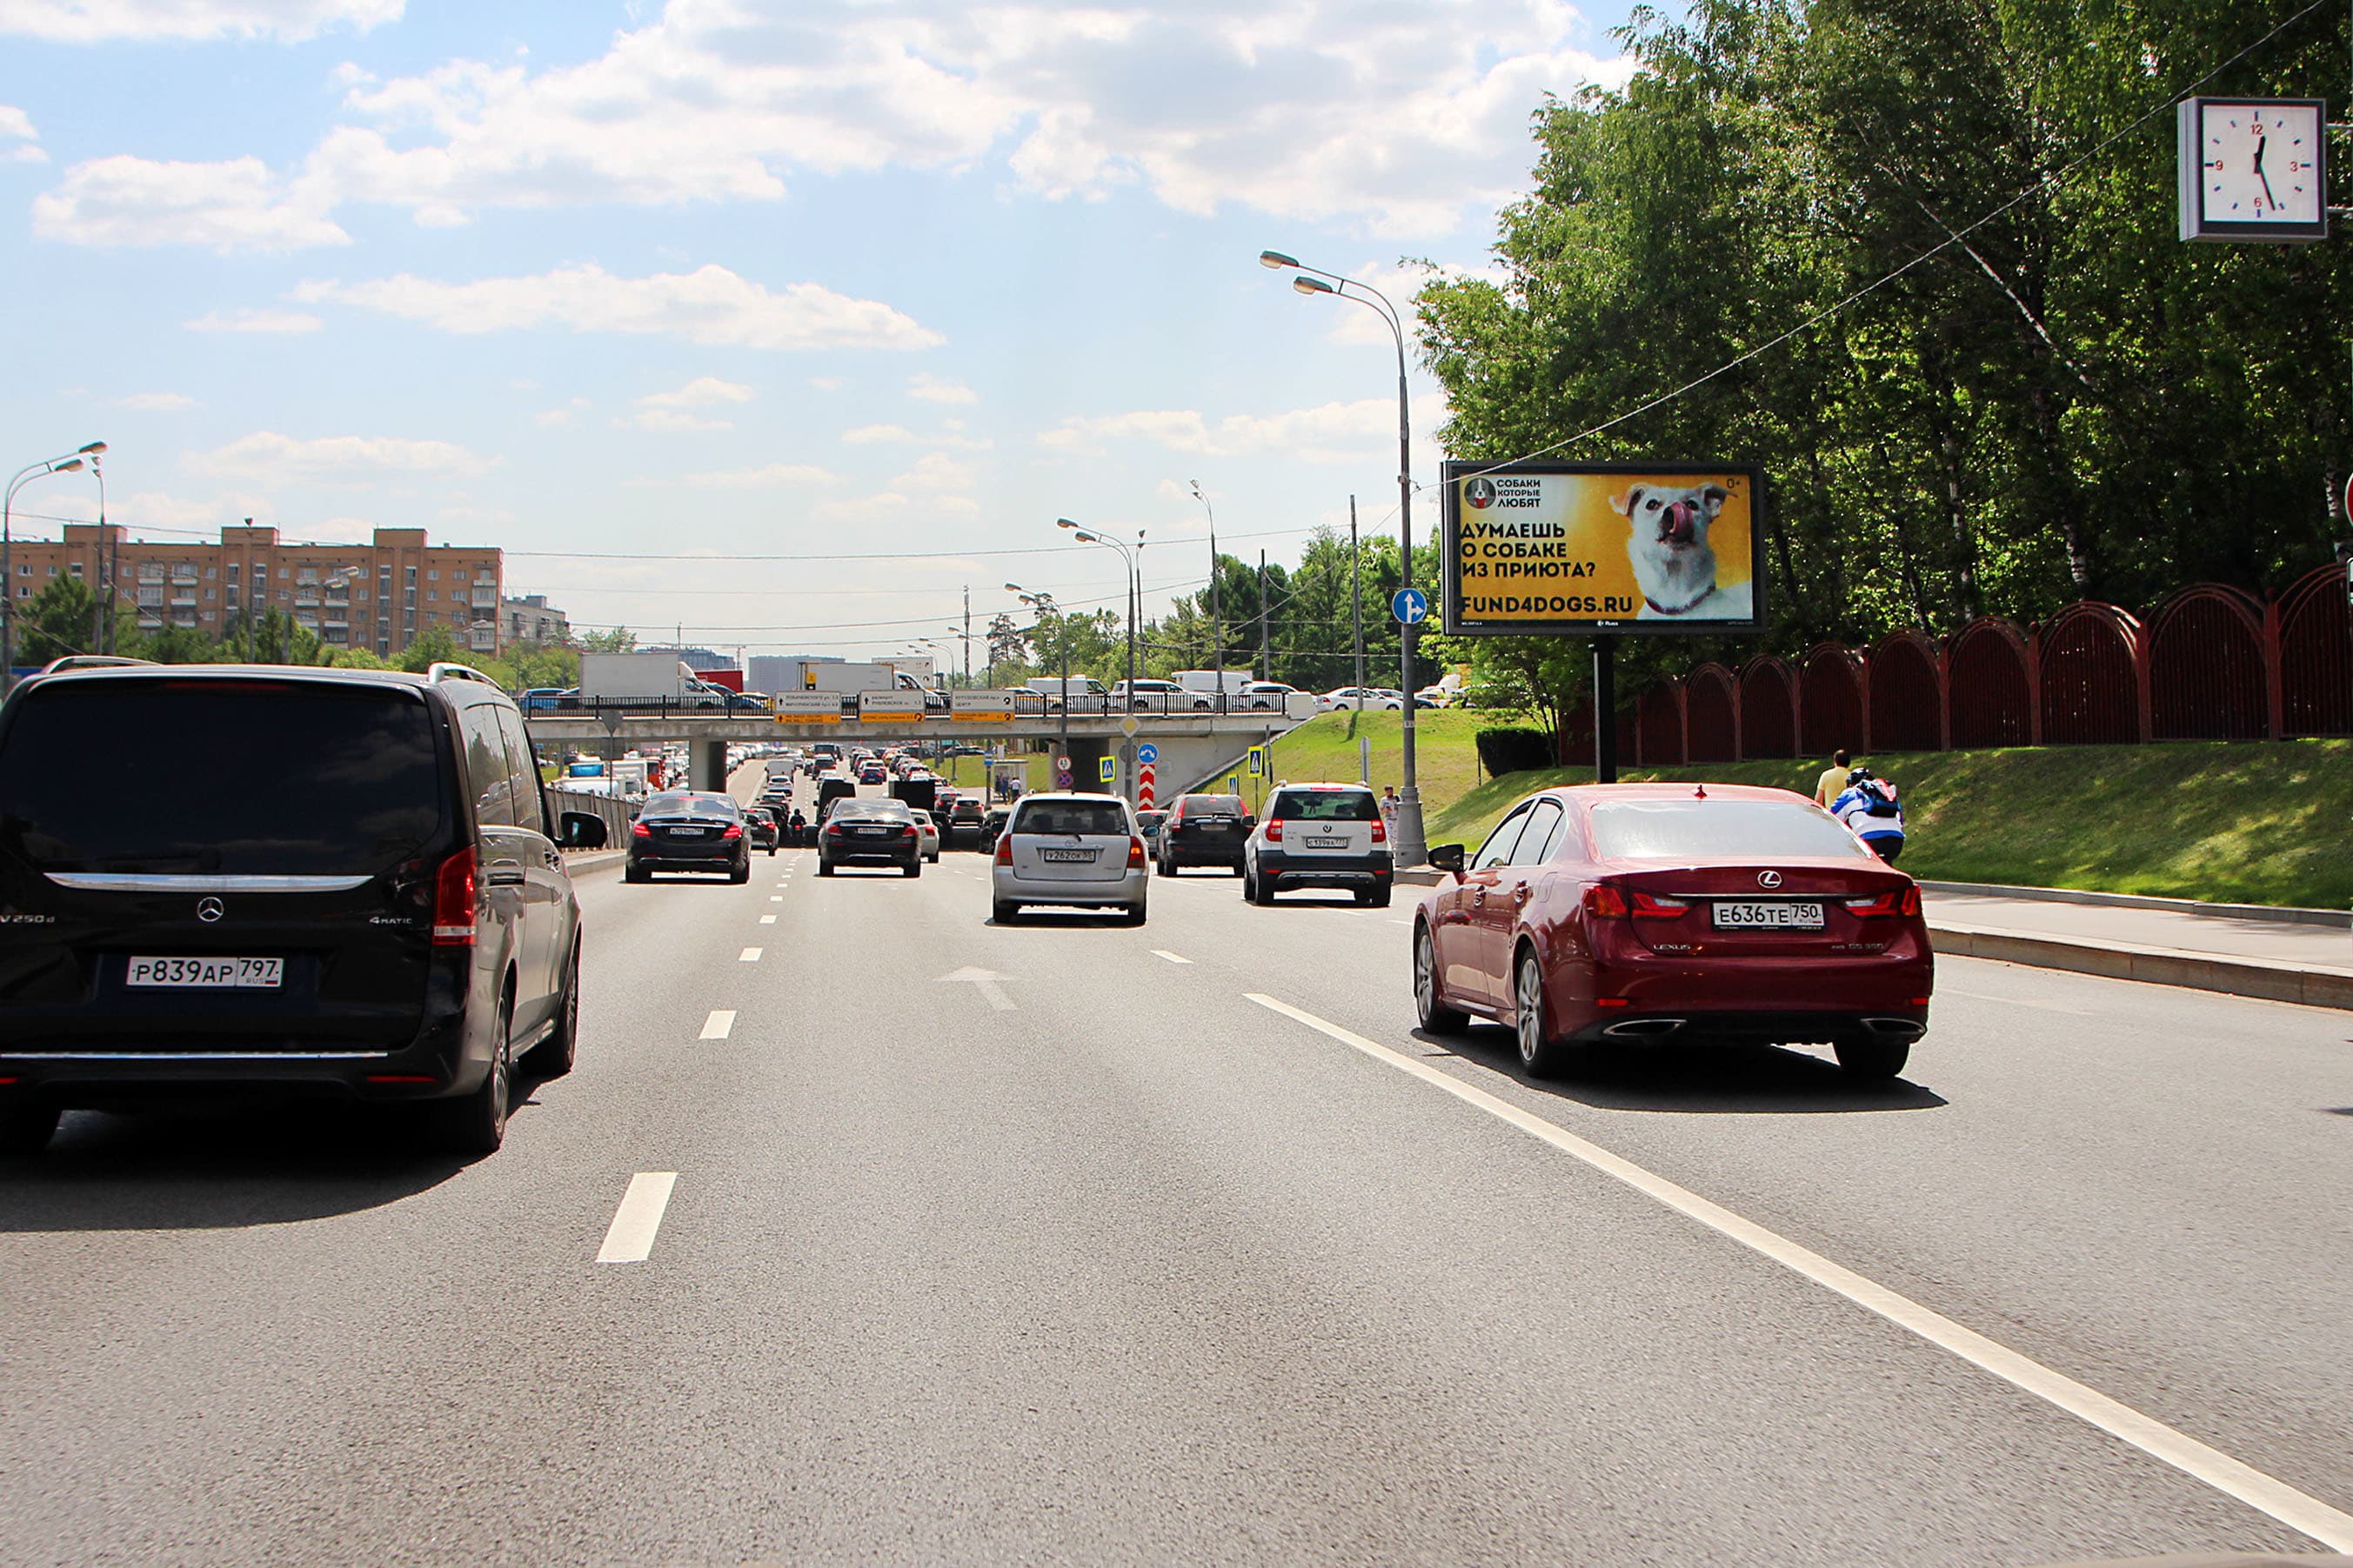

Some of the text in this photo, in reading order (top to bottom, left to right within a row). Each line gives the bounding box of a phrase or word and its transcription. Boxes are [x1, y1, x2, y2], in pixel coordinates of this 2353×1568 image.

[2251, 124, 2263, 136] 12
[2215, 160, 2223, 171] 9
[2289, 161, 2298, 172] 3
[2254, 197, 2263, 208] 6
[1497, 479, 1541, 488] СОБАКИ
[1497, 498, 1541, 508] ЛЮБЯТ
[1461, 523, 1566, 539] ДУМАЕШЬ
[1461, 542, 1567, 557] О СОБАКЕ
[1462, 561, 1595, 577] ИЗ ПРИЮТА?
[1461, 596, 1633, 612] FUND4DOGS.RU
[1720, 905, 1818, 923] Е636ТЕ 750
[137, 960, 277, 983] Р839АР 797
